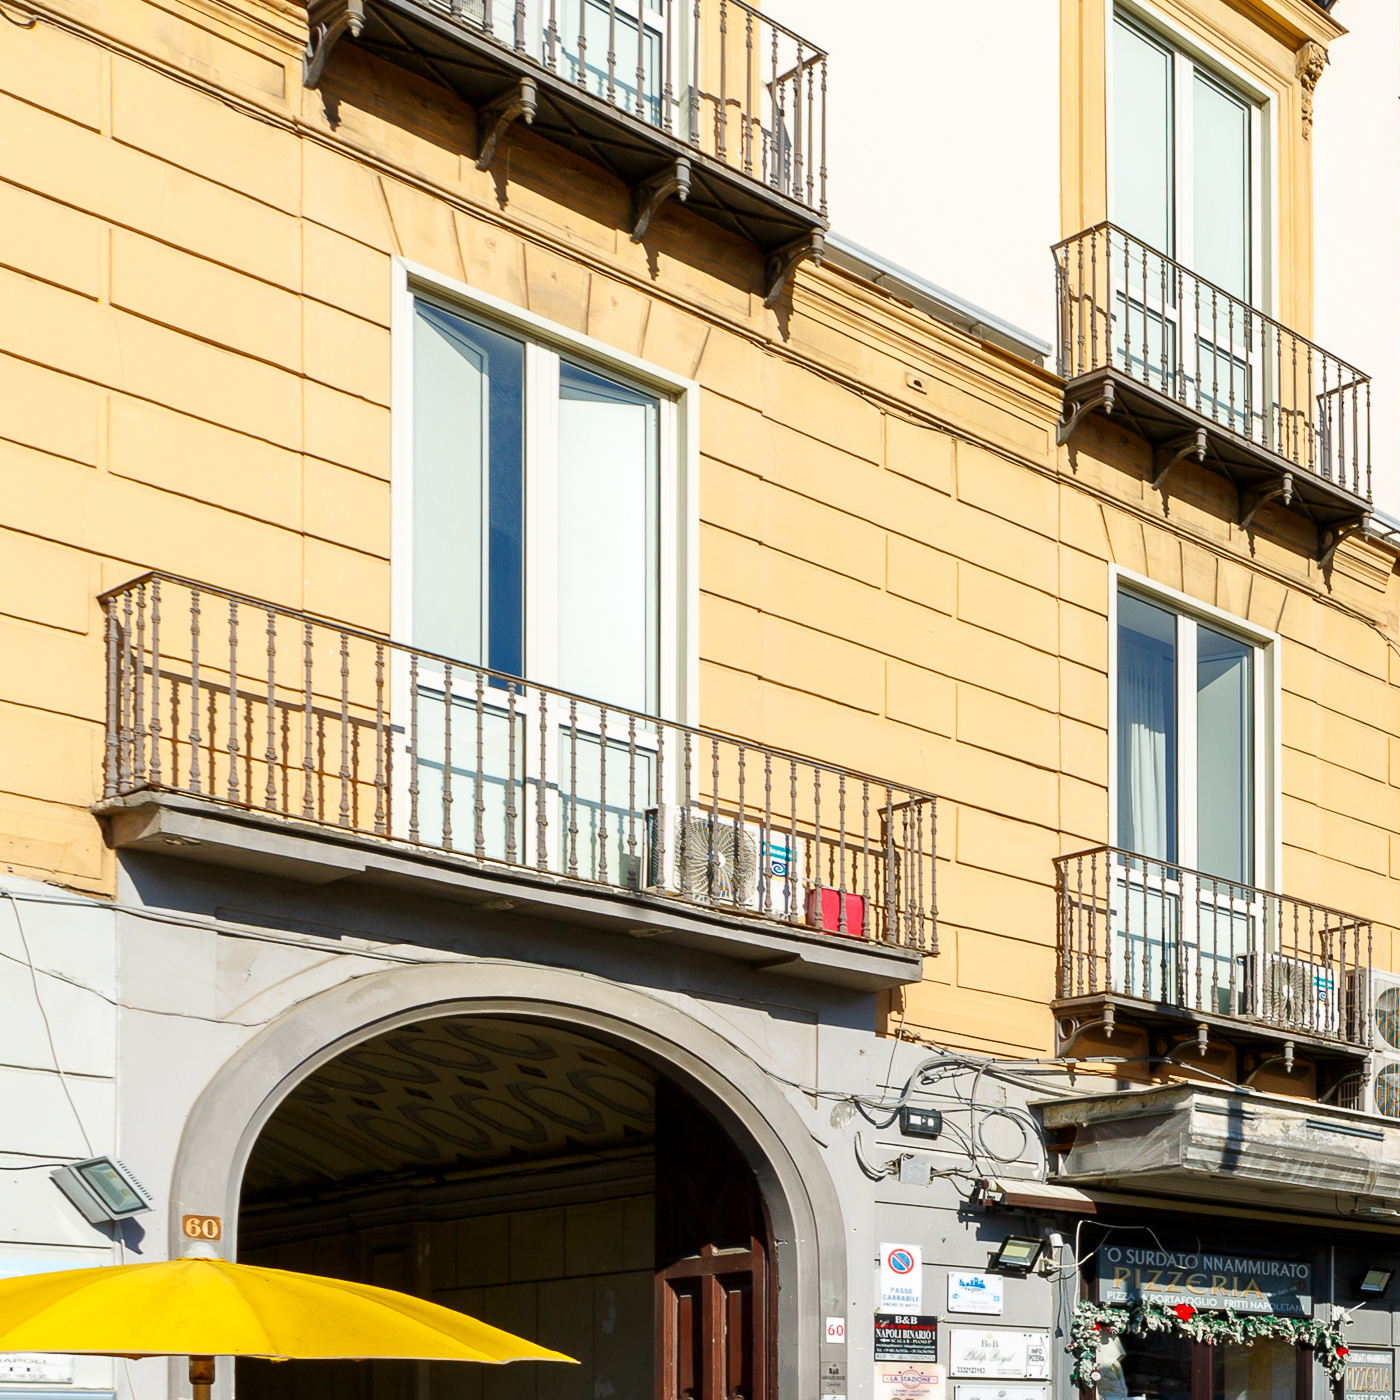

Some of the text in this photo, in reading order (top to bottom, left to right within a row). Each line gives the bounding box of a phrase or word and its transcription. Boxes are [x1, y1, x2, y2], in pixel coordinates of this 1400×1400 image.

[185, 1217, 219, 1239] 60
[1126, 1249, 1199, 1270] SURDATO
[1203, 1256, 1309, 1279] NNAMMURATO
[1112, 1266, 1264, 1300] PIZZERIA
[882, 1294, 919, 1302] CARRABILE
[1106, 1290, 1135, 1301] PIZZA
[1224, 1298, 1249, 1309] FRITTI
[1250, 1300, 1305, 1312] NAPOLETANI
[895, 1315, 918, 1325] B&B
[827, 1324, 844, 1336] 60
[875, 1328, 902, 1339] NAPOLI
[902, 1330, 932, 1340] BINARIO
[981, 1339, 999, 1348] B&B
[1346, 1367, 1391, 1392] PIZZERIA
